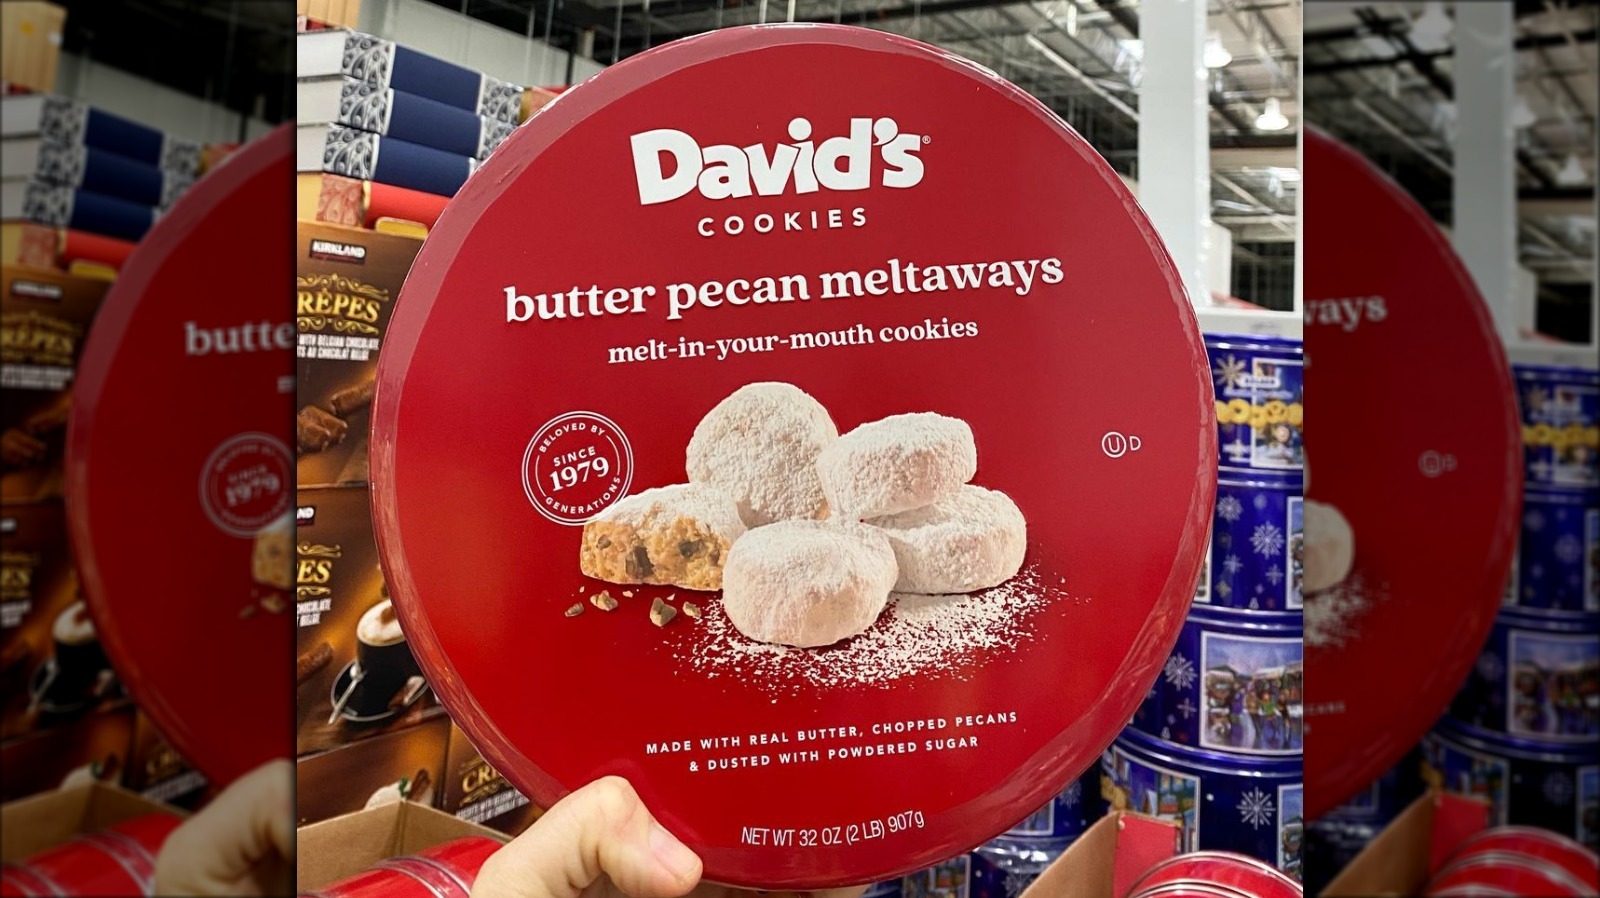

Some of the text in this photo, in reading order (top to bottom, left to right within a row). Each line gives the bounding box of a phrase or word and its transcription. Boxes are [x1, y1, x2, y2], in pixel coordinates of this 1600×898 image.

[698, 208, 865, 236] COOKIES
[312, 241, 365, 258] KIRKLAND
[504, 258, 1063, 322] butter pecan meltaways
[609, 318, 978, 363] melt-in-your-mouth cookies
[539, 423, 605, 453] BELOVED BY
[554, 447, 595, 466] SINCE
[550, 457, 608, 491] 1979
[546, 477, 620, 513] GENERATIONS
[647, 712, 1016, 753] MADE WITH REAL BUTTER, CHOPPED PECANS
[690, 737, 977, 771] & DUSTED WITH POWDERED SUGAR
[742, 811, 924, 846] NET WT 32 OZ (2 LB) 907g
